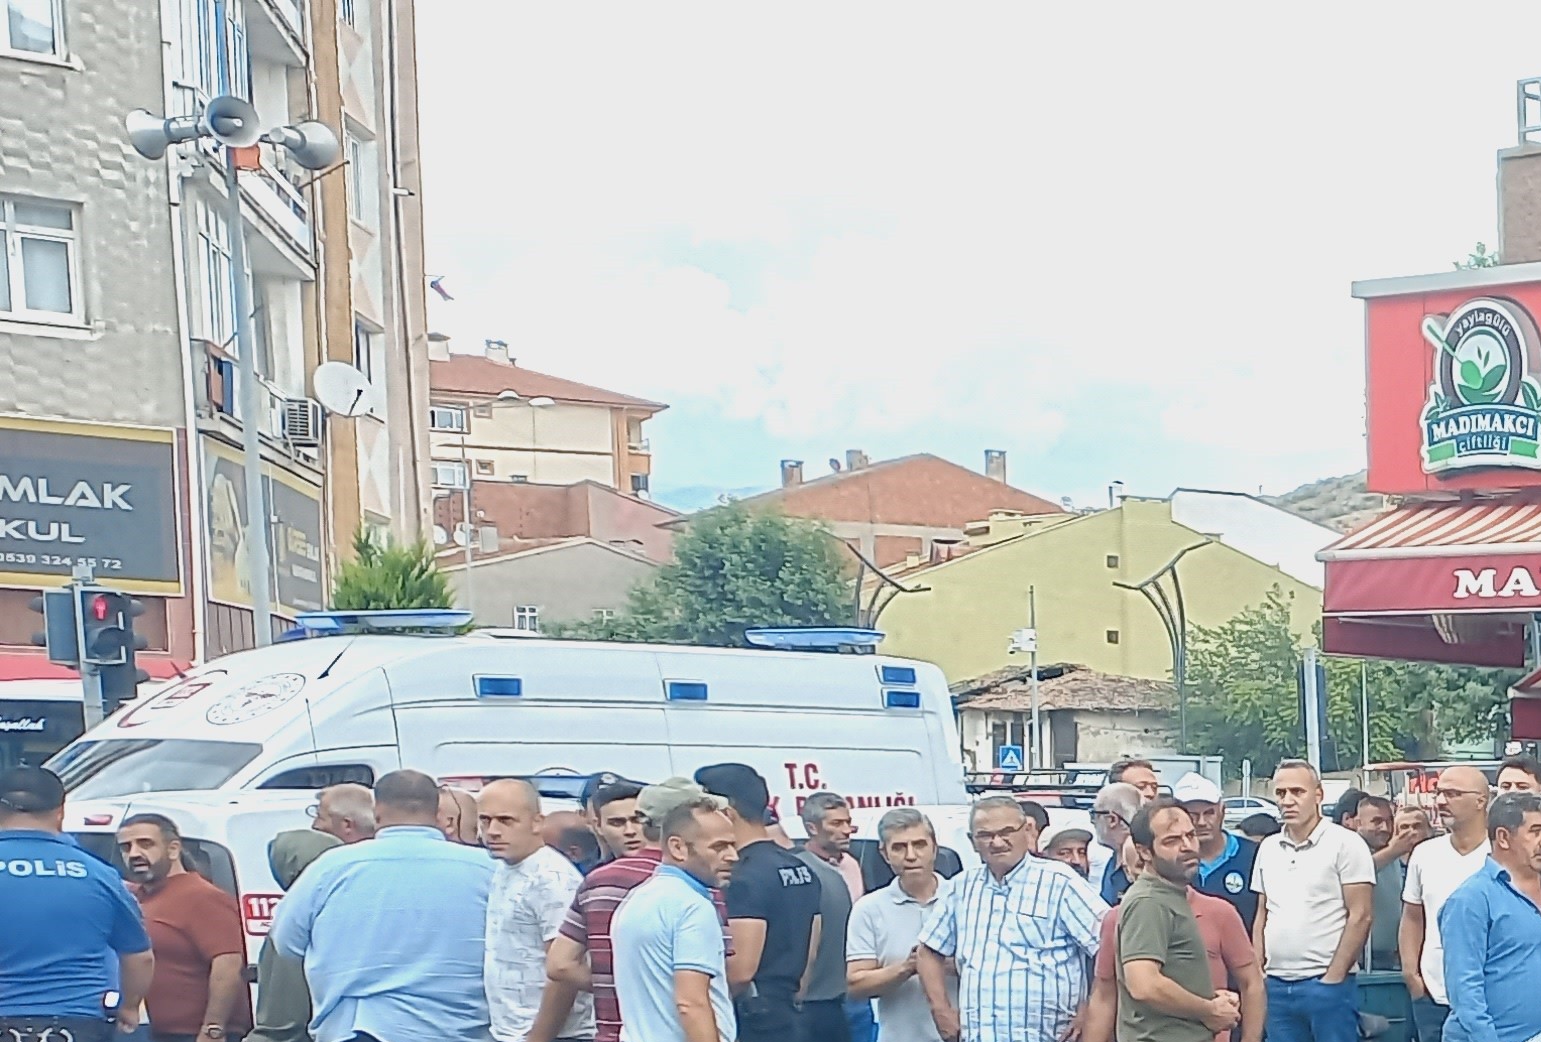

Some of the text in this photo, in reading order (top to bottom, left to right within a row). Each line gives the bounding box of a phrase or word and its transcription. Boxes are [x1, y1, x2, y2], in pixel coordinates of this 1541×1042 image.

[1431, 413, 1535, 441] MADIMAKCI
[41, 555, 72, 566] 324
[102, 559, 122, 569] 72
[784, 763, 827, 789] T.C.
